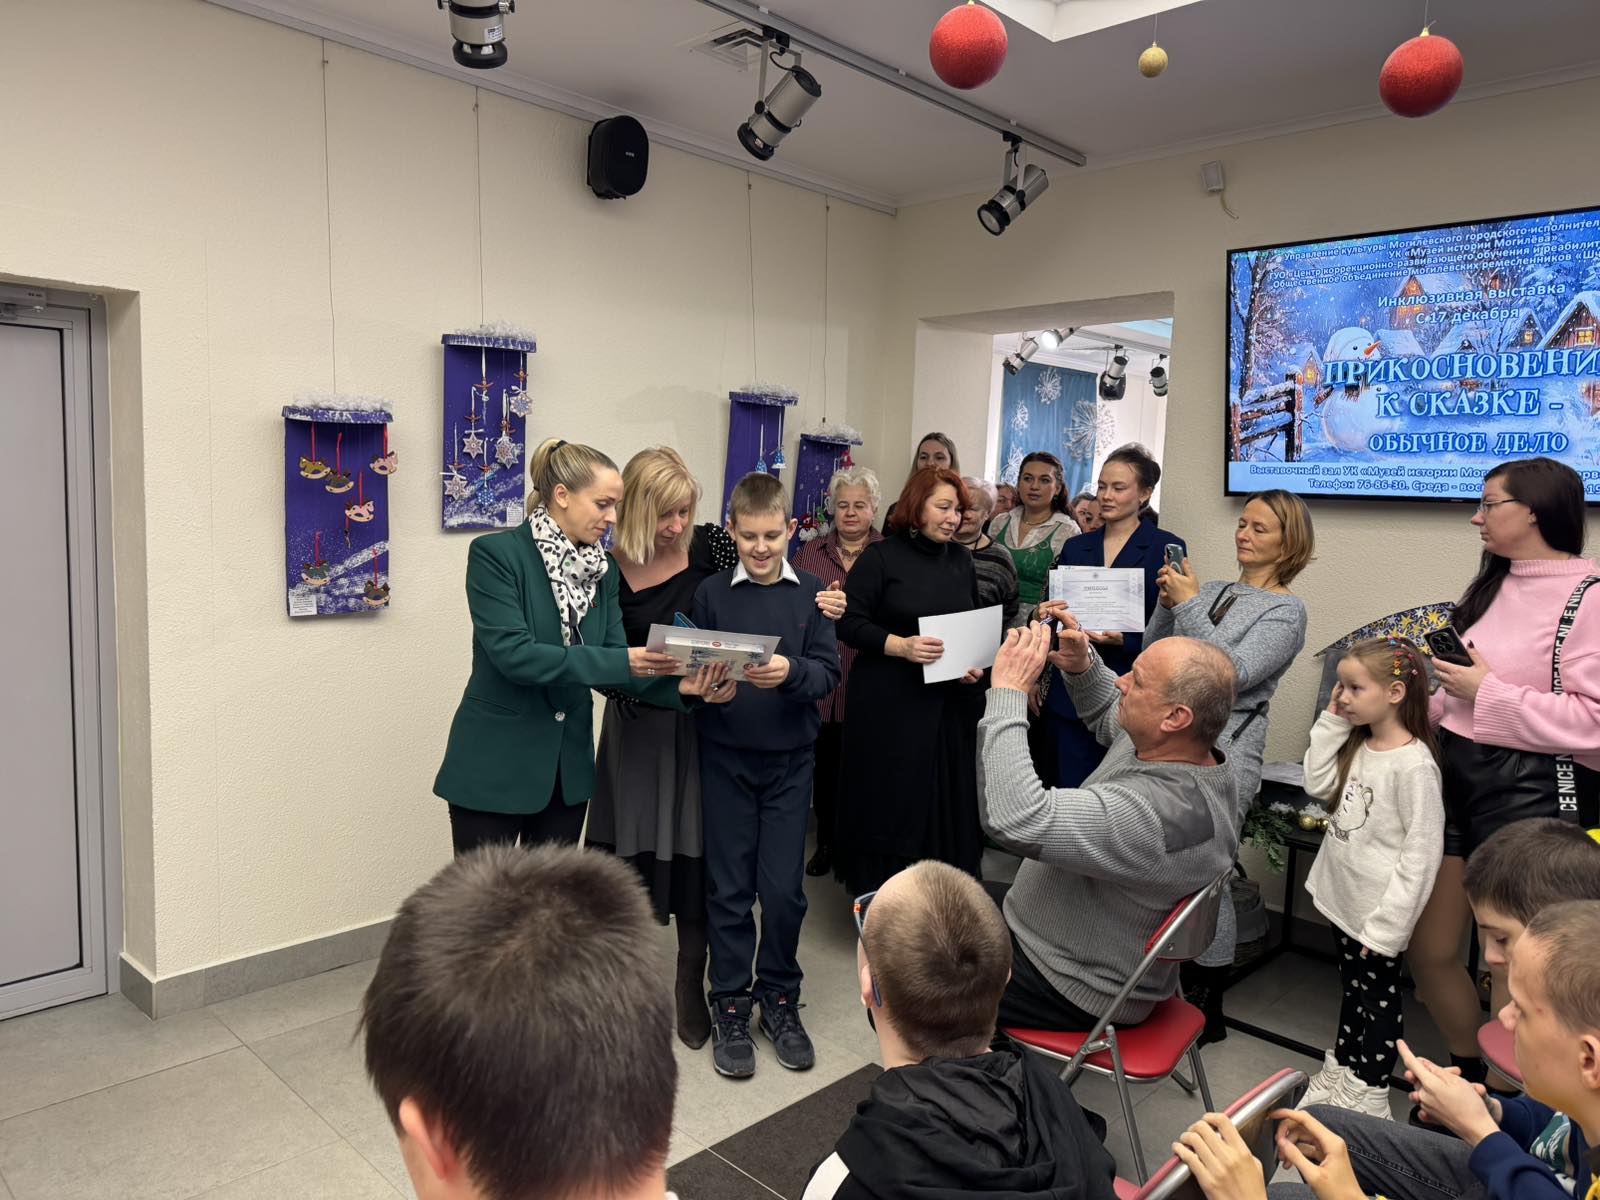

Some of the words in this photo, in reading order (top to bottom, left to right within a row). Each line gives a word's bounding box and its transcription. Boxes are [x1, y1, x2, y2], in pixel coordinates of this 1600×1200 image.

[1284, 248, 1339, 261] Управление
[1341, 244, 1387, 256] культуры
[1465, 228, 1527, 242] городского
[1388, 249, 1401, 259] УК
[1404, 245, 1444, 257] «Музей
[1447, 242, 1491, 253] истории
[1269, 271, 1286, 280] ГУО
[1477, 248, 1530, 260] обучения
[1273, 275, 1340, 288] Общественное
[1342, 269, 1408, 283] объединение
[1482, 254, 1572, 270] ремесленников
[1378, 288, 1483, 308] Инклюзивная
[1488, 283, 1566, 299] выставка
[1416, 312, 1426, 324] С
[1430, 311, 1446, 324] 17
[1451, 307, 1519, 325] декабря
[1323, 349, 1600, 385] ПРИКОСНОВЕНИ
[1376, 391, 1400, 418] К
[1408, 388, 1541, 417] СКАЗКЕ
[1368, 432, 1487, 453] ОБЫЧНОЕ
[1492, 431, 1568, 454] ДЕЛО
[1250, 464, 1320, 475] Выставочный
[1322, 466, 1341, 476] зал
[1343, 465, 1358, 476] УК
[1360, 465, 1405, 478] «Музей
[1407, 467, 1457, 479] истории
[1308, 478, 1356, 490] Телефон
[1412, 480, 1448, 493] Среда
[1556, 764, 1575, 793] NICE
